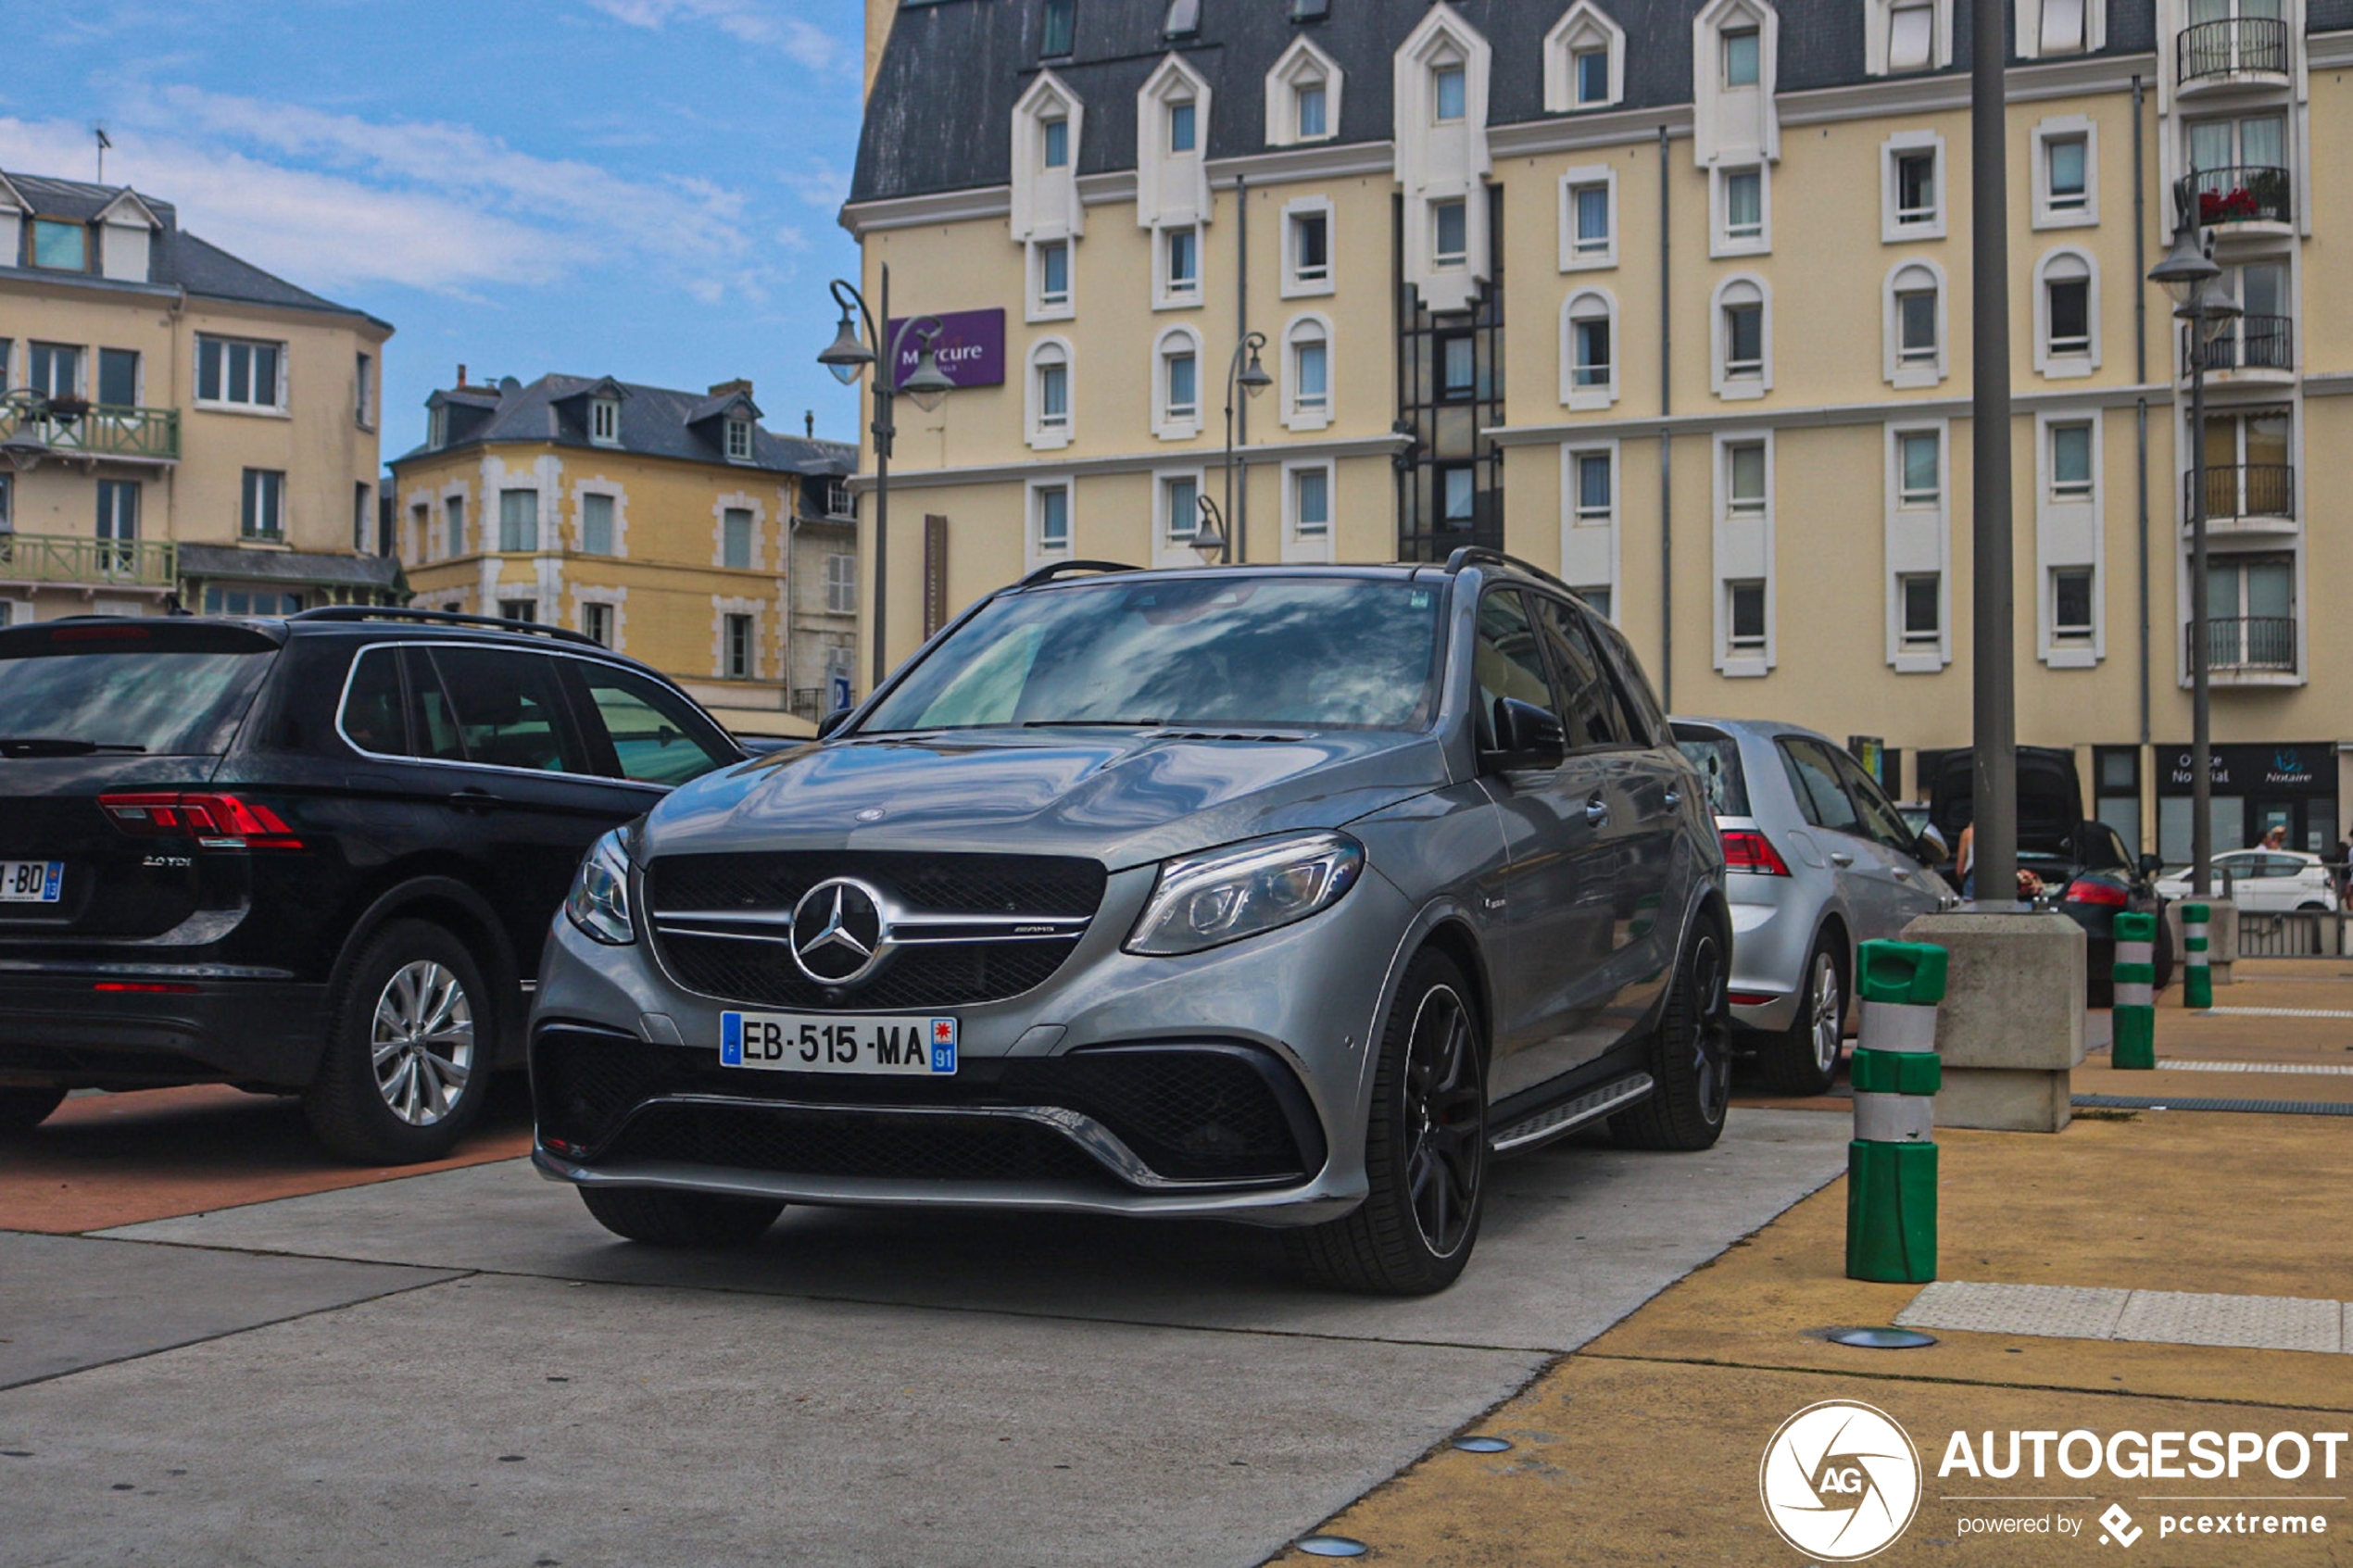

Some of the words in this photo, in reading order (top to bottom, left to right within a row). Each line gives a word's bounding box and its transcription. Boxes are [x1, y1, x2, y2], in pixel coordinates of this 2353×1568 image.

[2265, 771, 2312, 784] Notaire
[728, 1044, 736, 1057] F
[935, 1048, 952, 1068] 91
